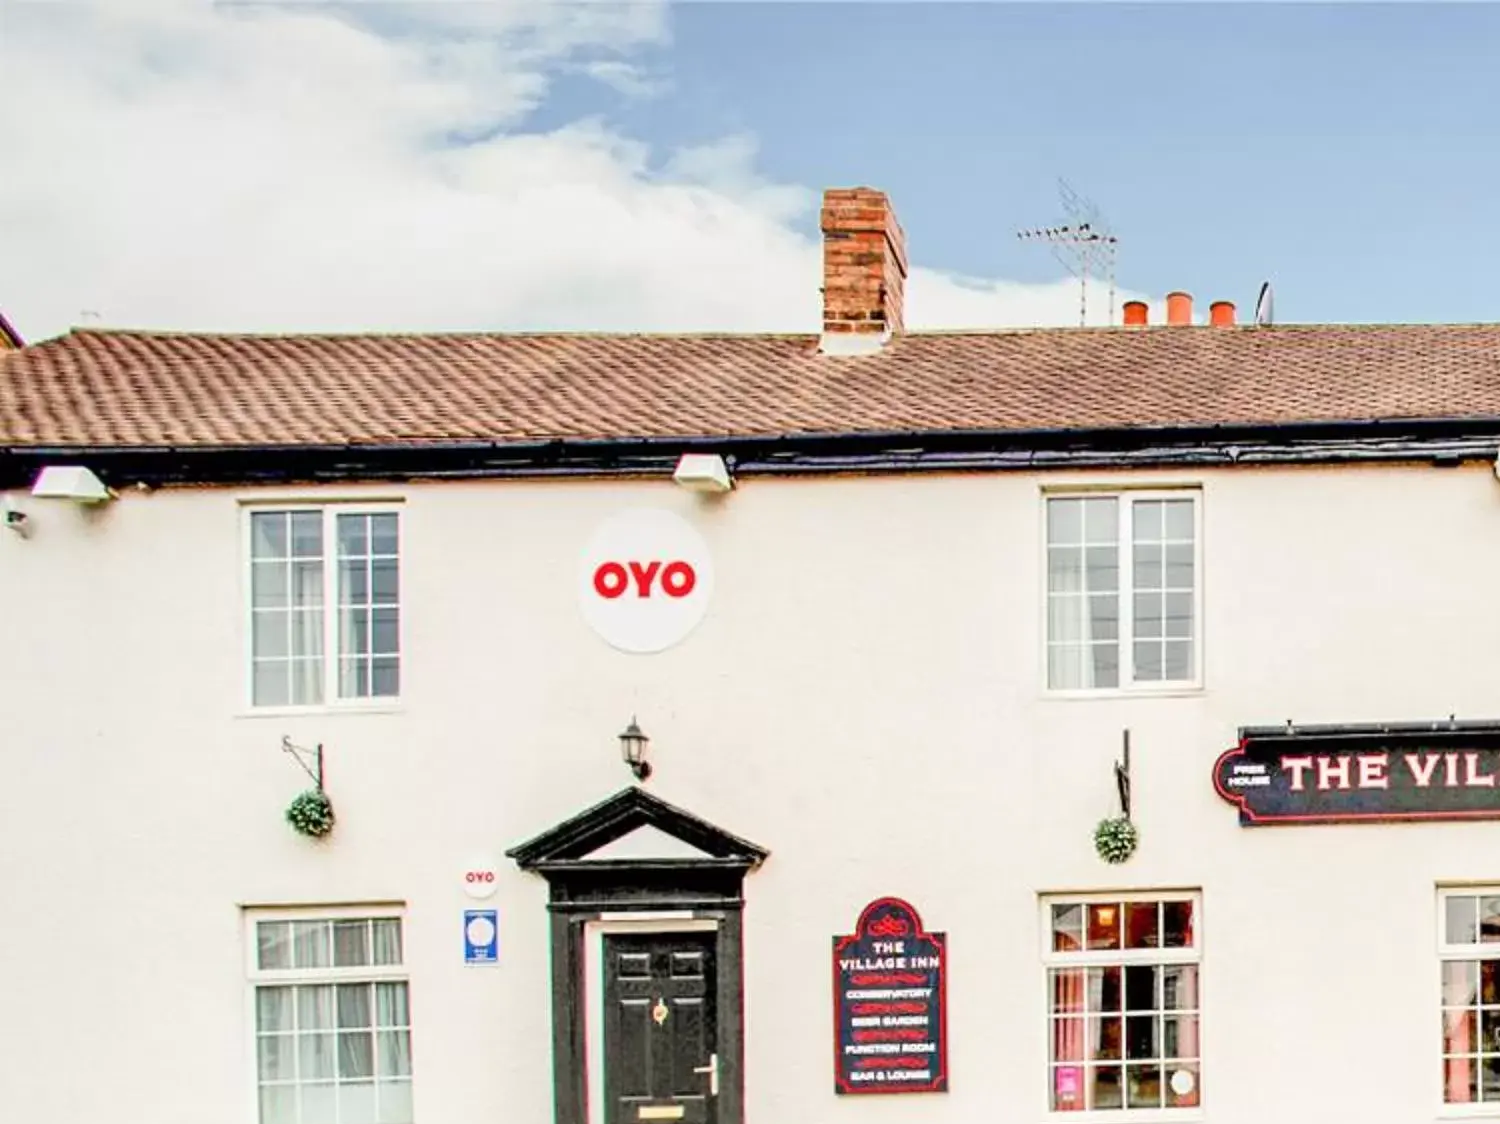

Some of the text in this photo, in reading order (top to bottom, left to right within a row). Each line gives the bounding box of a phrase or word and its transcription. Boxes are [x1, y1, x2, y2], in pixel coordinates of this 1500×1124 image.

[593, 561, 696, 599] OYO
[1280, 753, 1389, 790] THE
[1228, 776, 1270, 786] HOUSE
[465, 871, 495, 883] OYO
[872, 941, 905, 954] THE
[839, 955, 940, 971] VILLAGE INN
[882, 1016, 928, 1025] GARDEN
[845, 1043, 935, 1054] FUNCTION ROOM
[850, 1070, 875, 1081] BAR
